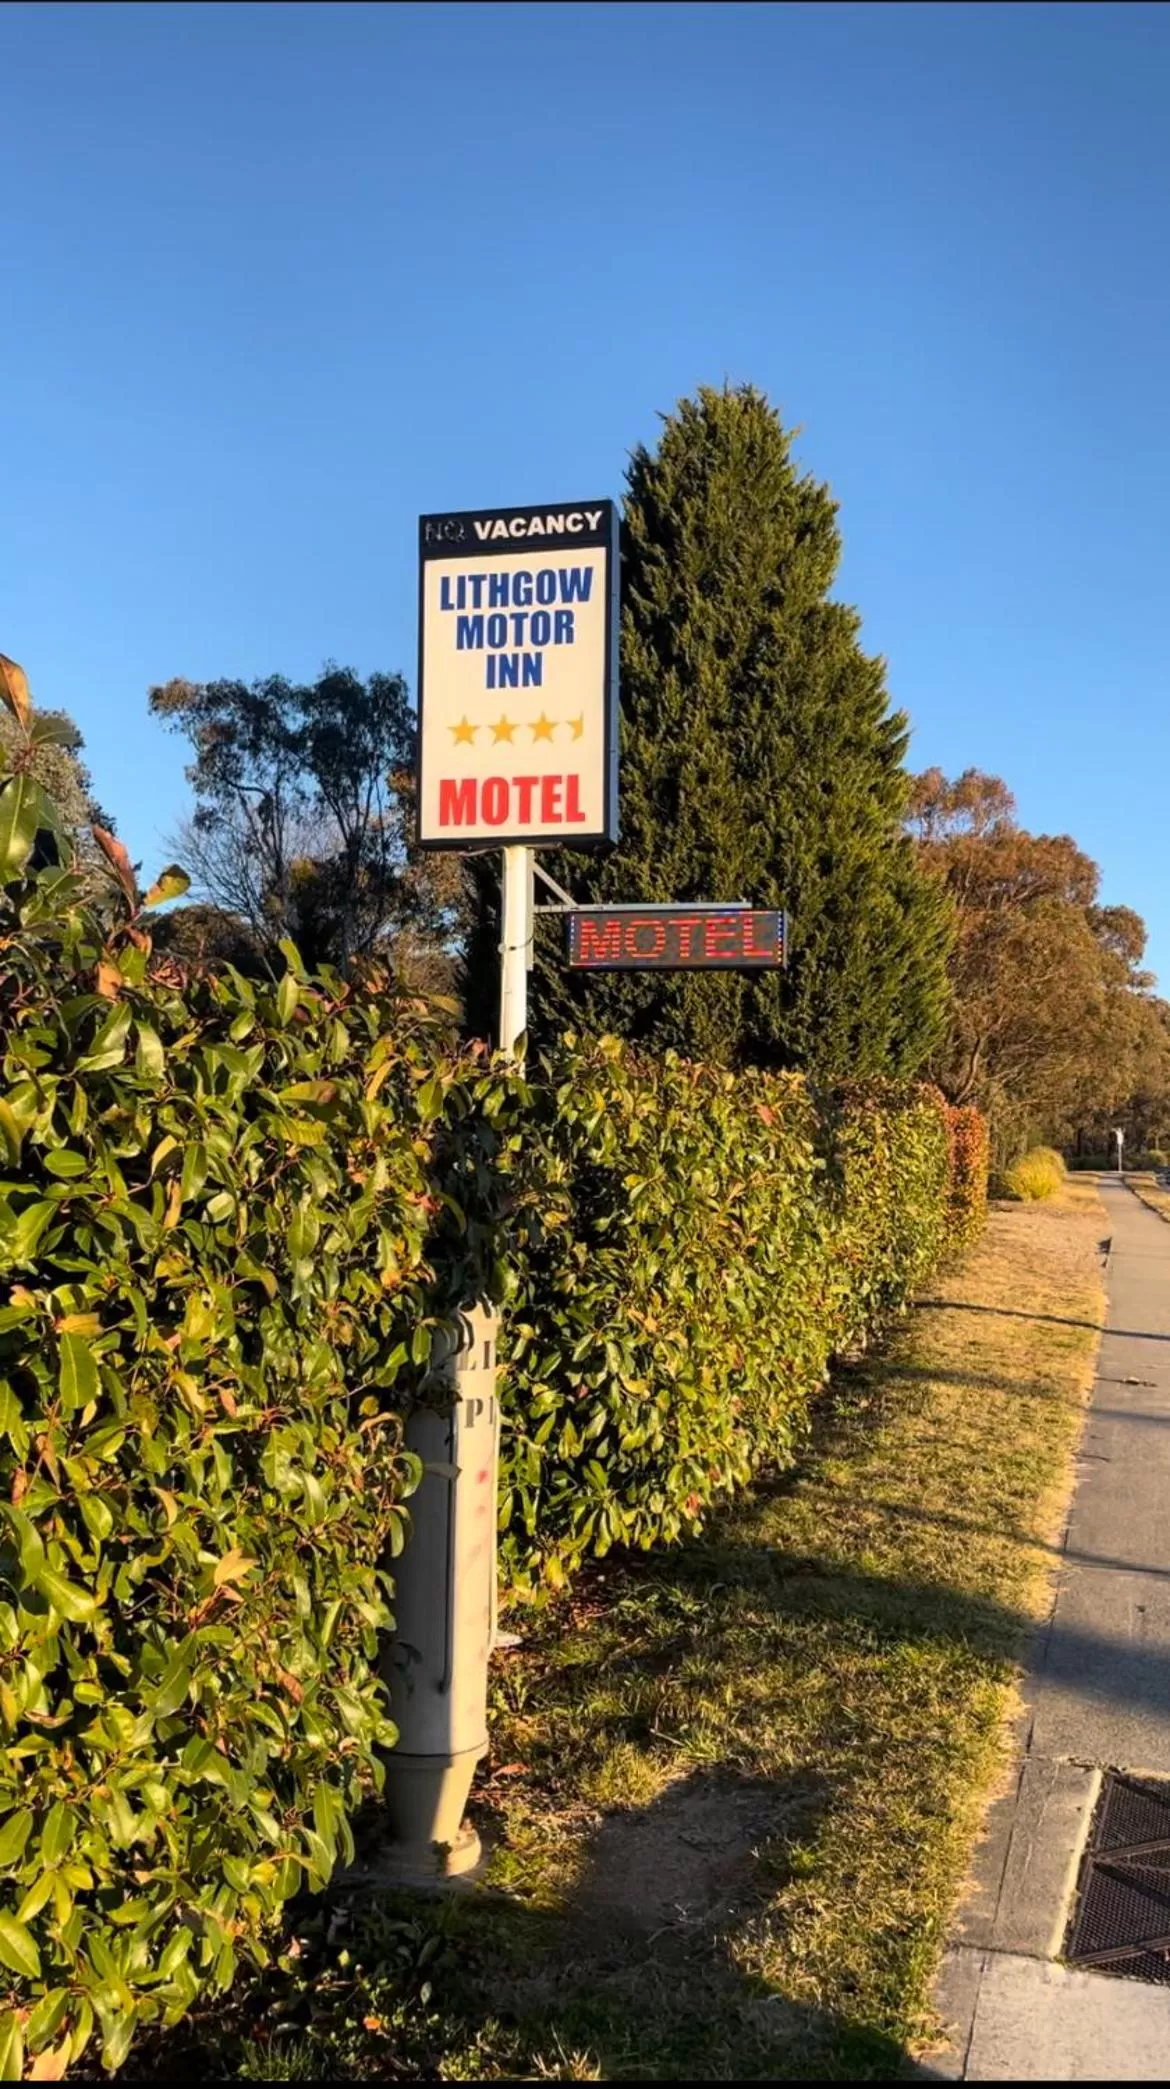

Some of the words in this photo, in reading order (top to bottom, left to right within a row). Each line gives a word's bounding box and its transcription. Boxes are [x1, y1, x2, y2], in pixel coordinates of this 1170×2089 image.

[473, 511, 603, 541] VACANCY
[440, 567, 593, 611] LITHGOW
[456, 609, 574, 650] MOTOR
[486, 652, 543, 689] INN
[439, 774, 586, 827] MOTEL
[579, 917, 774, 960] MOTEL
